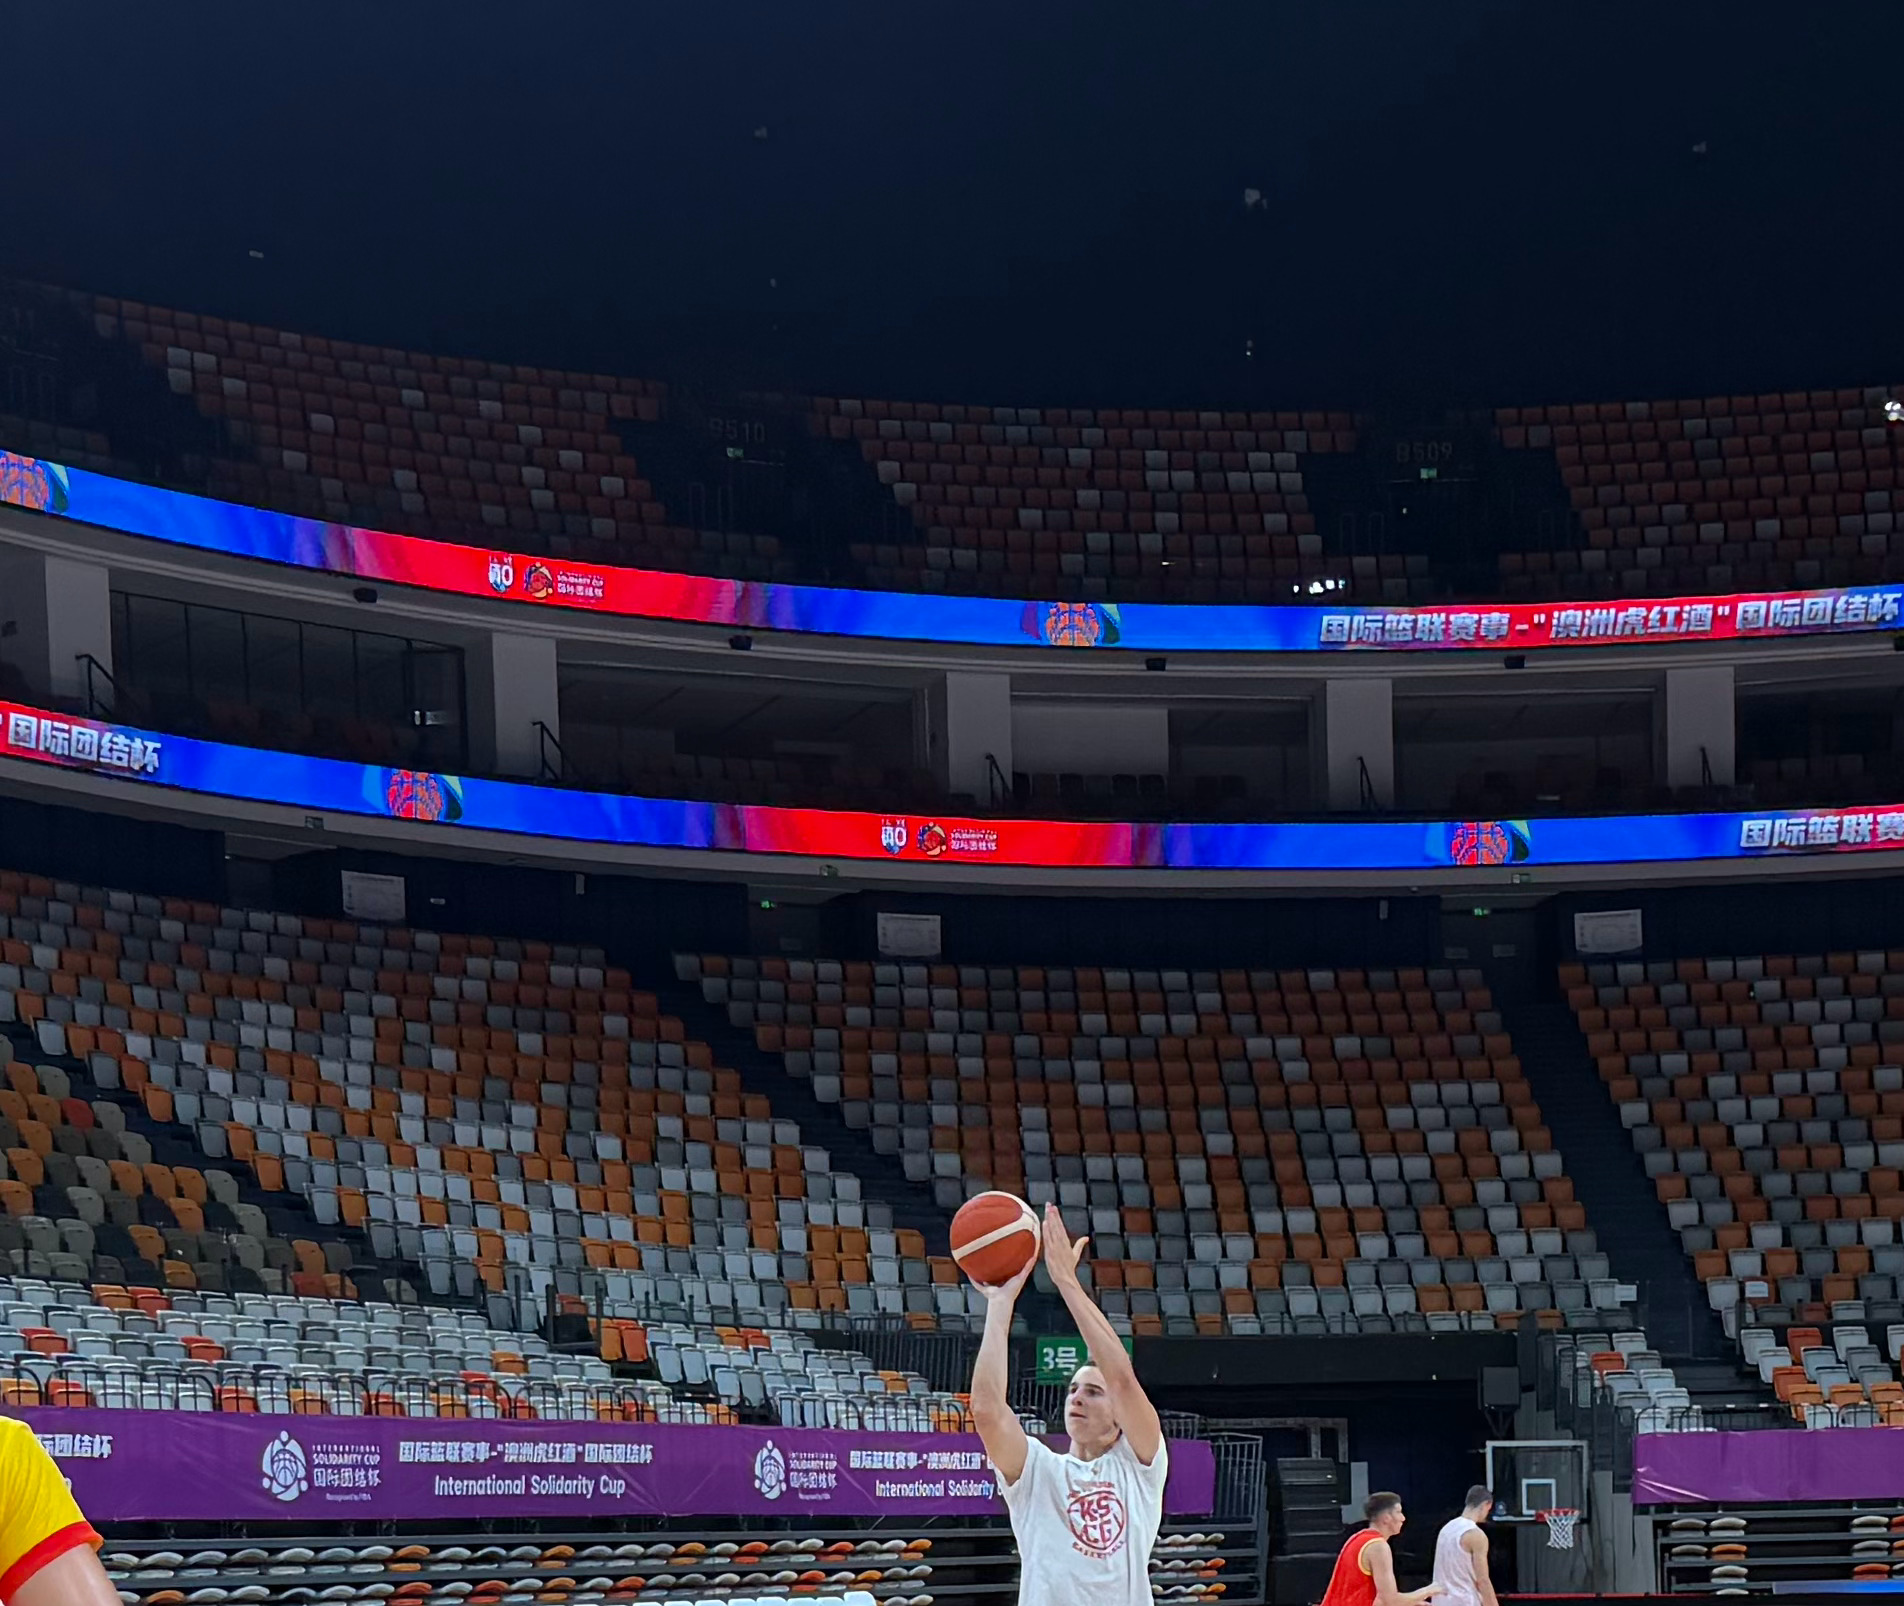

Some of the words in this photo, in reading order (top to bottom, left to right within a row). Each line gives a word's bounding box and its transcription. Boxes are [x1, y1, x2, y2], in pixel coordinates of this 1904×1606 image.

[1042, 1346, 1078, 1376] 3号
[434, 1475, 526, 1497] International
[531, 1474, 596, 1499] Solidarity
[599, 1476, 626, 1499] Cup
[875, 1480, 945, 1497] International
[948, 1480, 995, 1499] Solidarity
